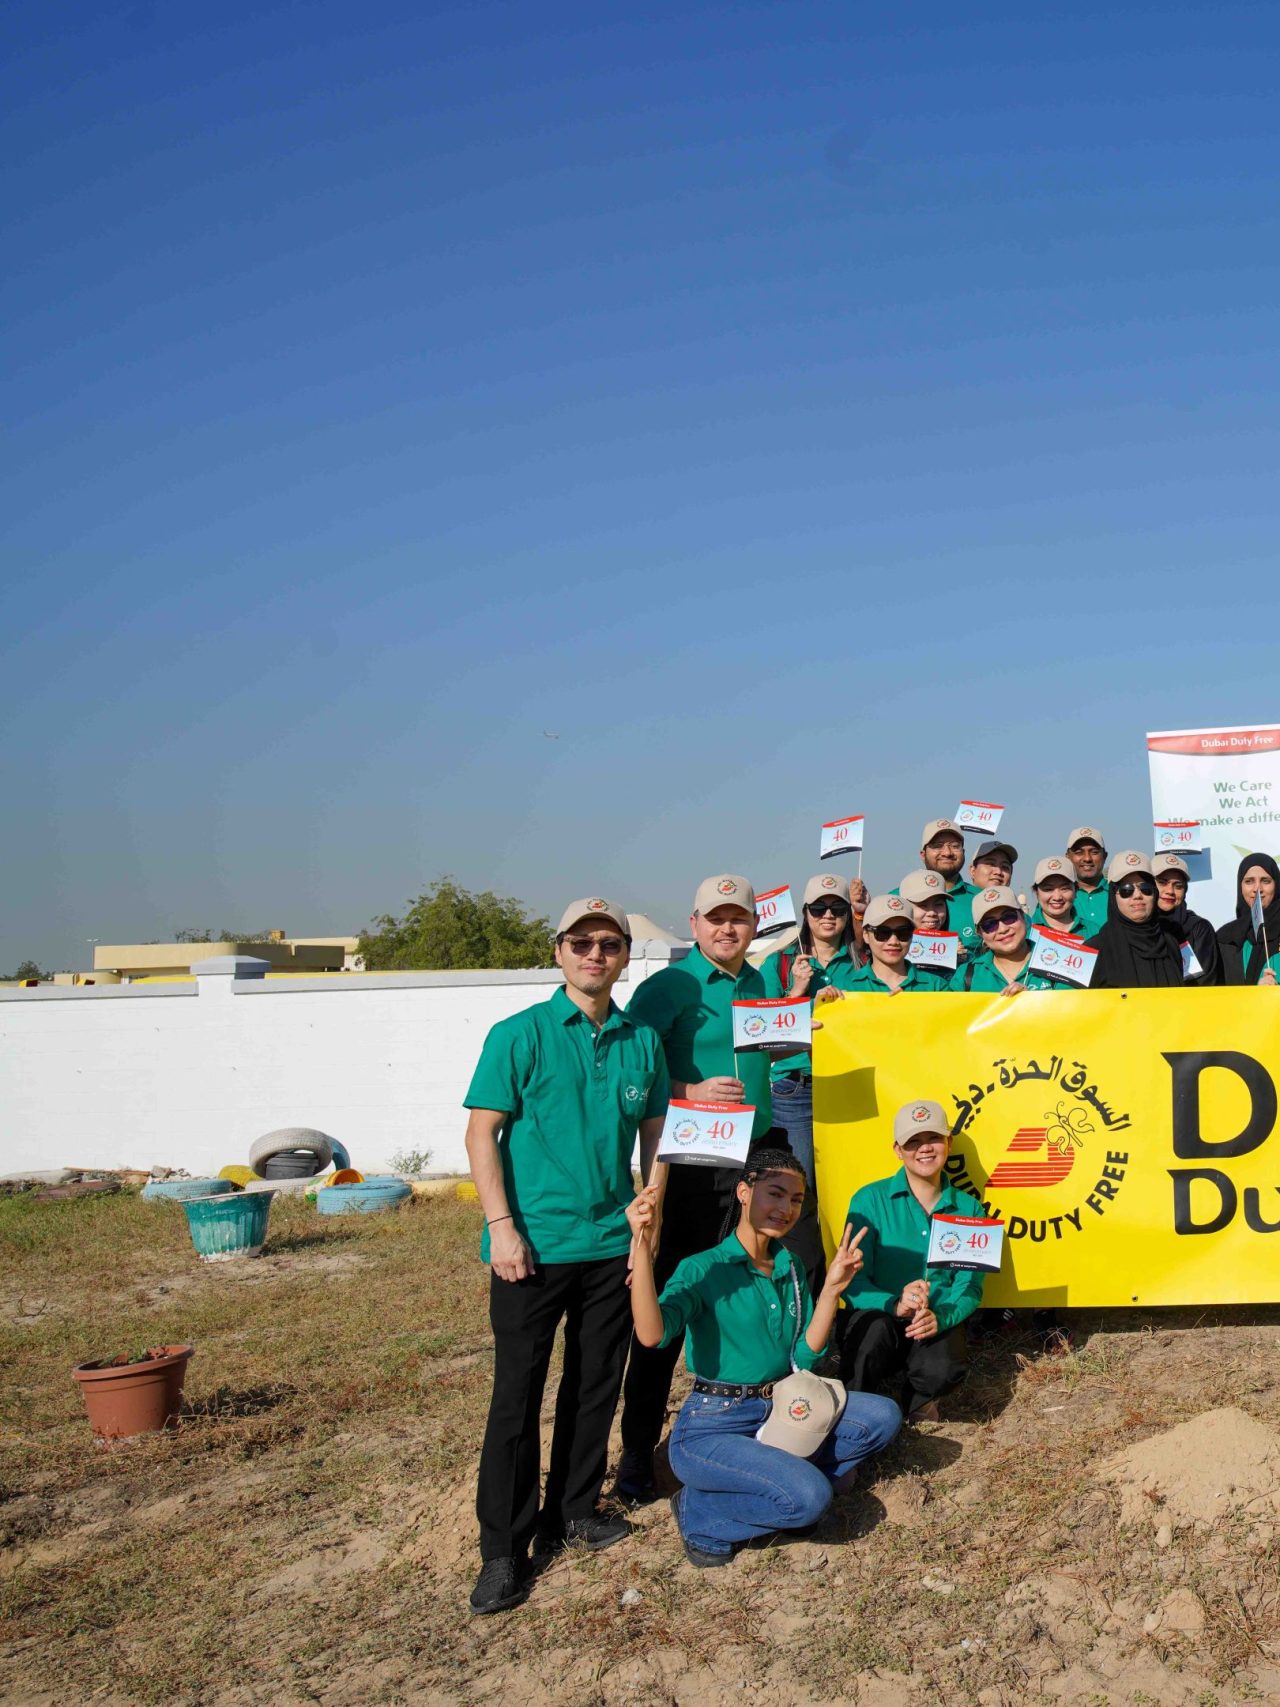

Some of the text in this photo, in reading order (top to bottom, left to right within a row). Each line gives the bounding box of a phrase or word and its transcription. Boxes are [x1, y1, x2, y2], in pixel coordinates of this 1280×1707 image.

[1231, 737, 1252, 747] Duty
[1254, 735, 1275, 745] Free
[1213, 780, 1273, 793] We Care
[1218, 795, 1269, 809] We Act
[1195, 814, 1233, 827] make
[1236, 816, 1245, 825] a
[1007, 1206, 1083, 1243] DUTY
[1085, 1150, 1129, 1216] FREE
